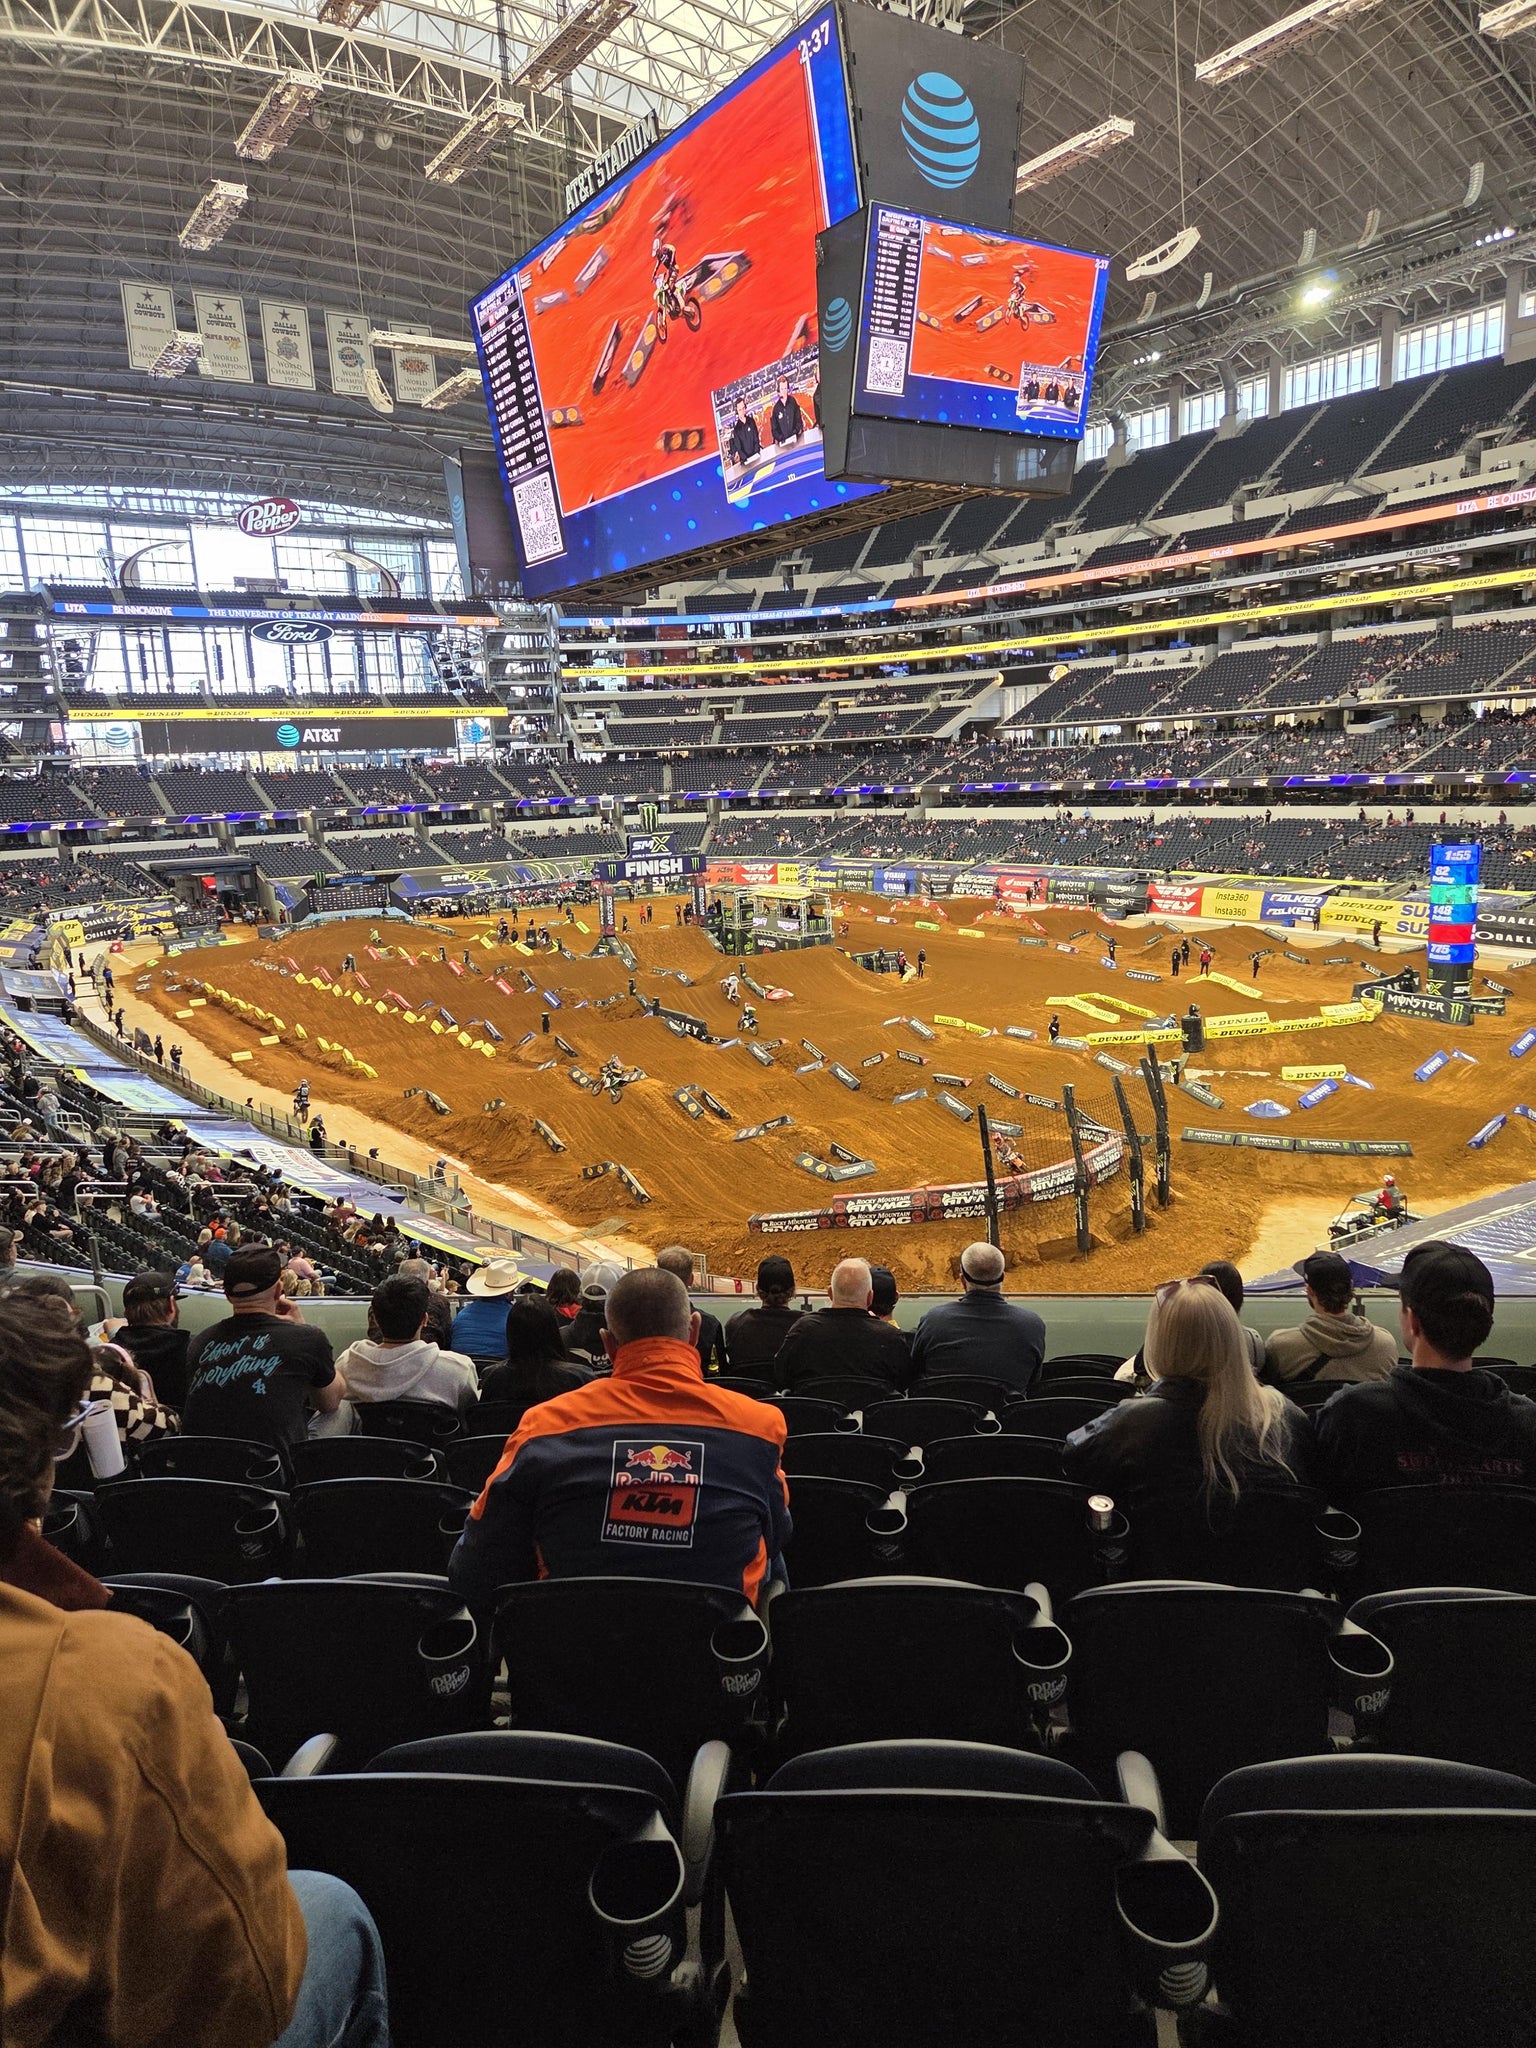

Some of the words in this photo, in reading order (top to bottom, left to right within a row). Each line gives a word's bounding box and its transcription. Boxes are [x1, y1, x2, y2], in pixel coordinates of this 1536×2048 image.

[798, 19, 829, 65] 2:37
[565, 165, 595, 215] AT&T
[595, 111, 658, 187] STADIUM
[136, 302, 162, 312] DALLAS
[134, 309, 166, 319] COWBOYS
[208, 313, 233, 321] DALLAS
[206, 320, 237, 328] COWBOYS
[274, 321, 297, 330] DALLAS
[204, 333, 223, 341] SUPER
[271, 328, 300, 337] COWBOYS
[338, 331, 361, 339] DALLAS
[336, 337, 364, 346] COWBOYS
[213, 354, 239, 363] WORLD
[277, 361, 303, 370] WORLD
[405, 378, 428, 387] WORLD
[1456, 502, 1479, 514] UTA
[1487, 496, 1500, 508] BE
[264, 503, 285, 518] Dr
[241, 505, 297, 533] Pepper
[1415, 548, 1428, 556] BOB
[1429, 545, 1446, 555] LILLY
[1286, 569, 1298, 577] DON
[1298, 565, 1325, 575] MEREDITH
[1459, 577, 1498, 588] DUNLOP
[1175, 586, 1190, 594] CHUCK
[1191, 583, 1210, 591] HOWLEY
[1397, 586, 1432, 597] DUNLOP
[1339, 596, 1372, 605] DUNLOP
[65, 603, 88, 613] UTA
[208, 608, 227, 618] THE
[228, 609, 280, 619] UNIVERSITY
[282, 610, 294, 619] OF
[294, 610, 321, 620] TEXAS
[323, 611, 334, 620] AT
[335, 611, 383, 623] ARLINGTON
[1283, 603, 1314, 613] DUNLOP
[1231, 610, 1261, 619] DUNLOP
[1182, 617, 1210, 625] DUNLOP
[267, 622, 320, 641] Ford
[73, 710, 114, 718] DUNLOP
[145, 711, 183, 719] DUNLOP
[303, 728, 341, 744] AT&T
[632, 835, 671, 853] SMX
[1445, 850, 1471, 861] 1:55
[625, 858, 683, 878] FINISH
[441, 869, 491, 882] SMX
[1056, 880, 1086, 888] MONSTER
[1055, 893, 1084, 901] MONSTER
[1215, 891, 1249, 902] Insta360
[1269, 893, 1323, 905] FALKEN
[1214, 906, 1246, 917] Insta360
[1266, 907, 1316, 916] FALKEN
[1339, 901, 1393, 912] DUNLOP
[1335, 913, 1388, 926] DUNLOP
[1388, 994, 1445, 1013] MONSTER
[1335, 1005, 1364, 1015] DUNLOP
[1394, 1007, 1435, 1018] ENERGY
[1219, 1016, 1268, 1026] DUNLOP
[1283, 1018, 1324, 1031] DUNLOP
[1339, 1017, 1364, 1025] DUNLOP
[1220, 1027, 1268, 1037] DUNLOP
[1099, 1035, 1141, 1043] DUNLOP
[1296, 1070, 1345, 1079] DUNLOP
[1195, 1131, 1223, 1140] MONSTER
[1250, 1136, 1280, 1144] MONSTER
[1309, 1140, 1341, 1149] MONSTER
[952, 1190, 972, 1198] ROCKY
[856, 1198, 877, 1206] ROCKY
[877, 1195, 912, 1205] MOUNTAIN
[857, 1212, 877, 1220] ROCKY
[877, 1210, 911, 1220] MOUNTAIN
[788, 1217, 818, 1225] MOUNTAIN
[199, 1335, 251, 1363] Effort
[253, 1333, 270, 1351] is
[190, 1354, 283, 1395] Everything
[621, 1491, 684, 1515] KTM
[606, 1523, 649, 1539] FACTORY
[652, 1528, 689, 1542] RACING
[431, 1669, 467, 1694] Pepper
[722, 1672, 758, 1694] Pepper
